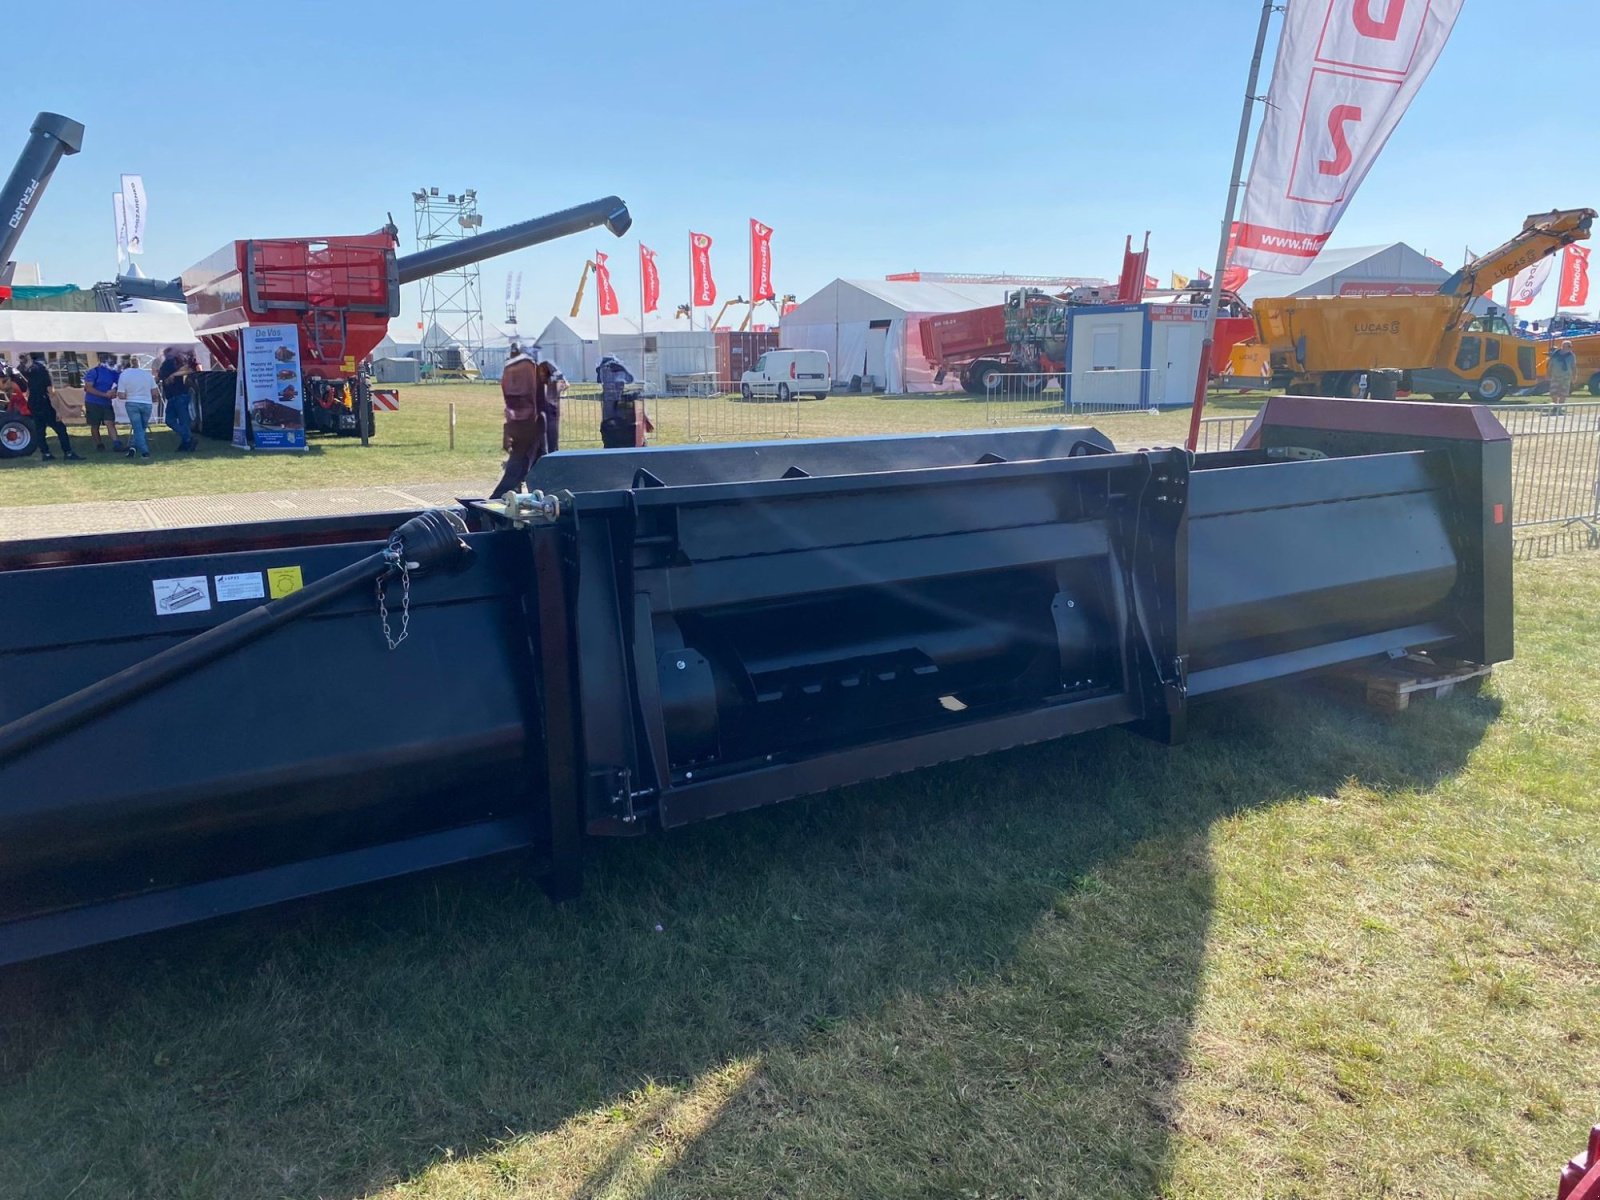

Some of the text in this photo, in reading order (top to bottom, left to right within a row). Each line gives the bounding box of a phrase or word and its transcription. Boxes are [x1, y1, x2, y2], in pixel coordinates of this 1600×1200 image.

[1494, 257, 1527, 279] LUCAS
[1569, 258, 1582, 303] Promodis
[1354, 323, 1389, 333] LUCAS
